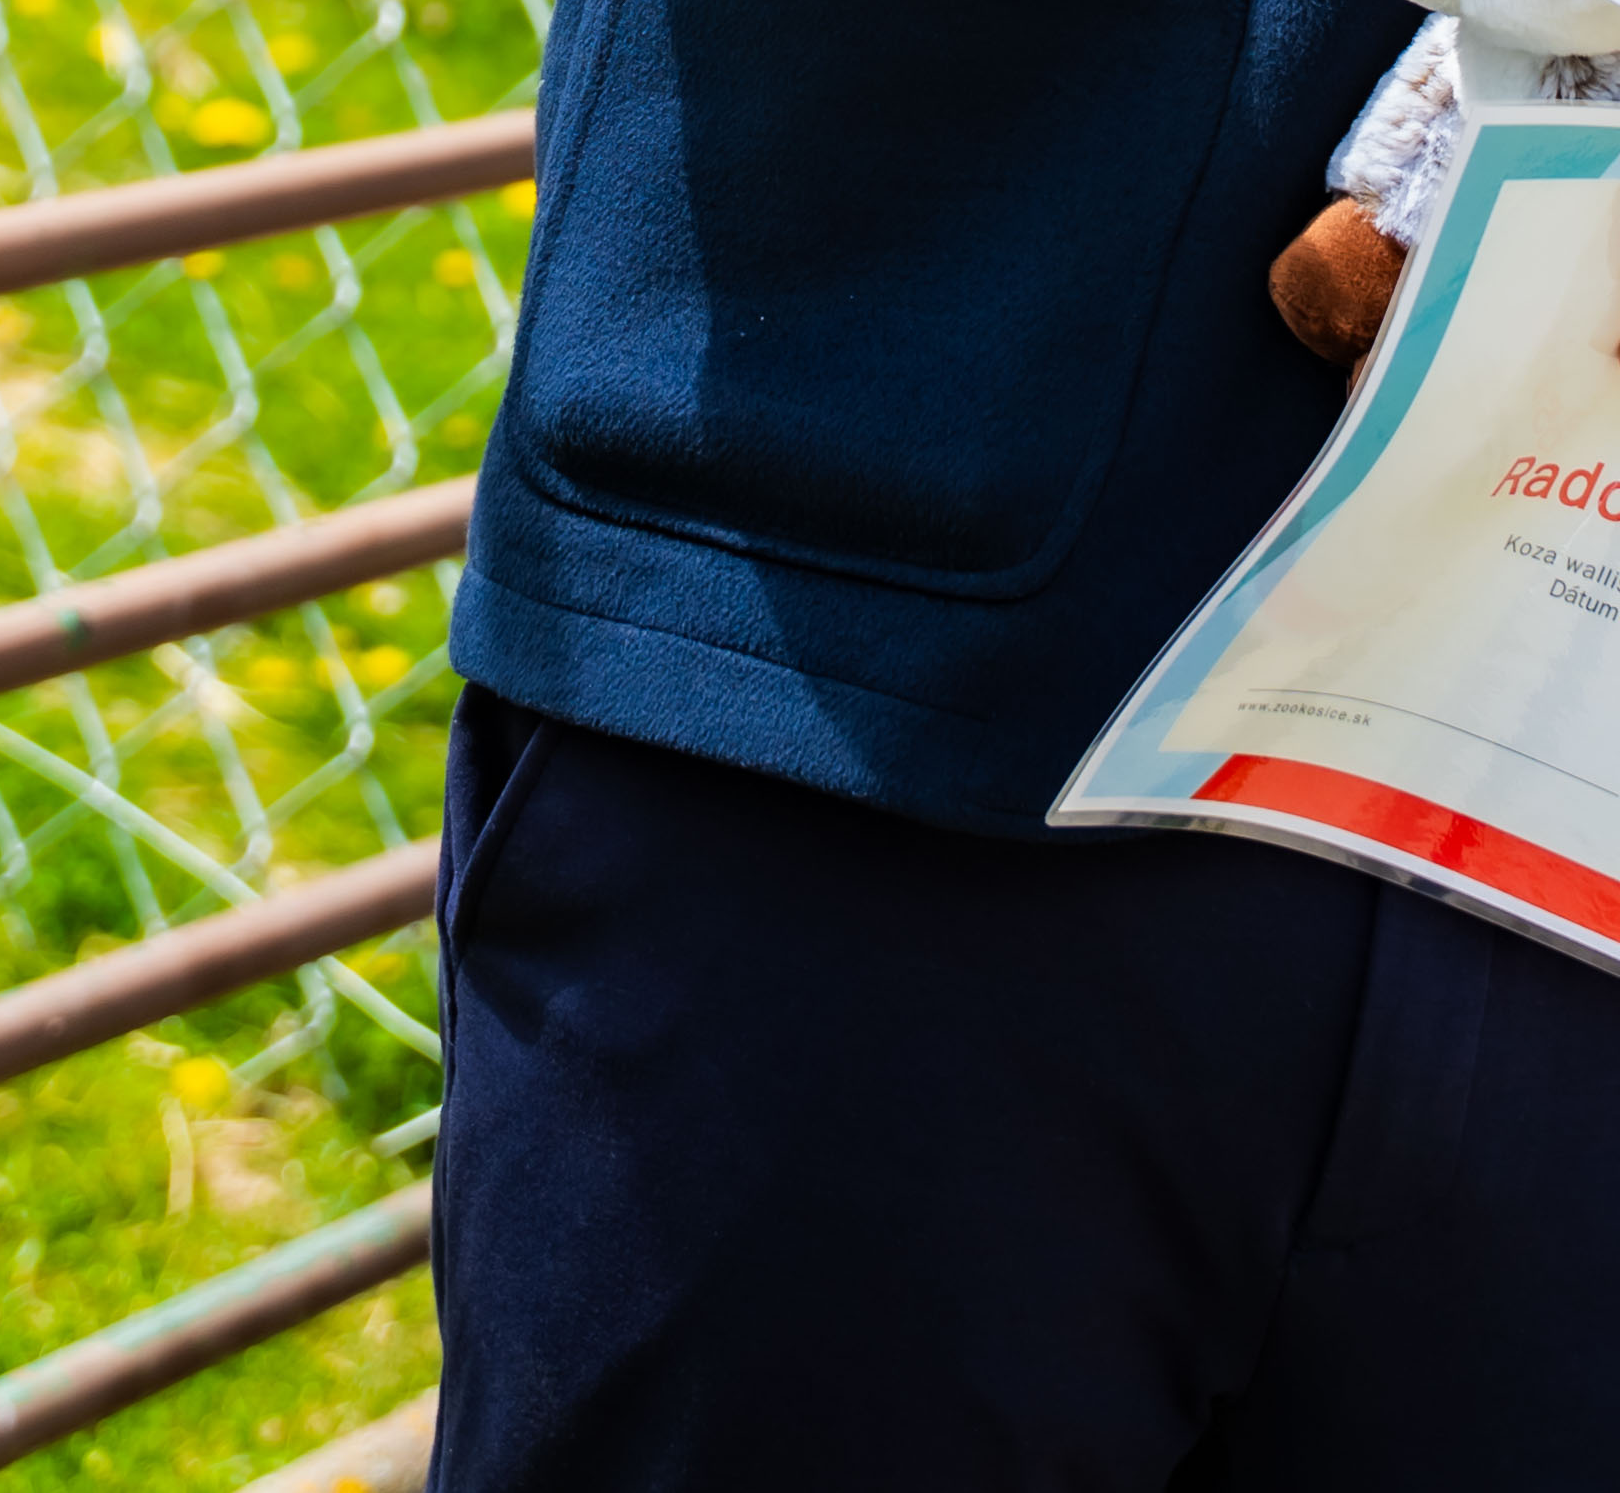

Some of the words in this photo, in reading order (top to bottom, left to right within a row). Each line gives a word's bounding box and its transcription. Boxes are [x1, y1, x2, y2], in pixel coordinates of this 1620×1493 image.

[1503, 534, 1558, 565] Koza
[1548, 577, 1620, 622] Dátum
[1237, 702, 1373, 727] www.zookosice.sk
